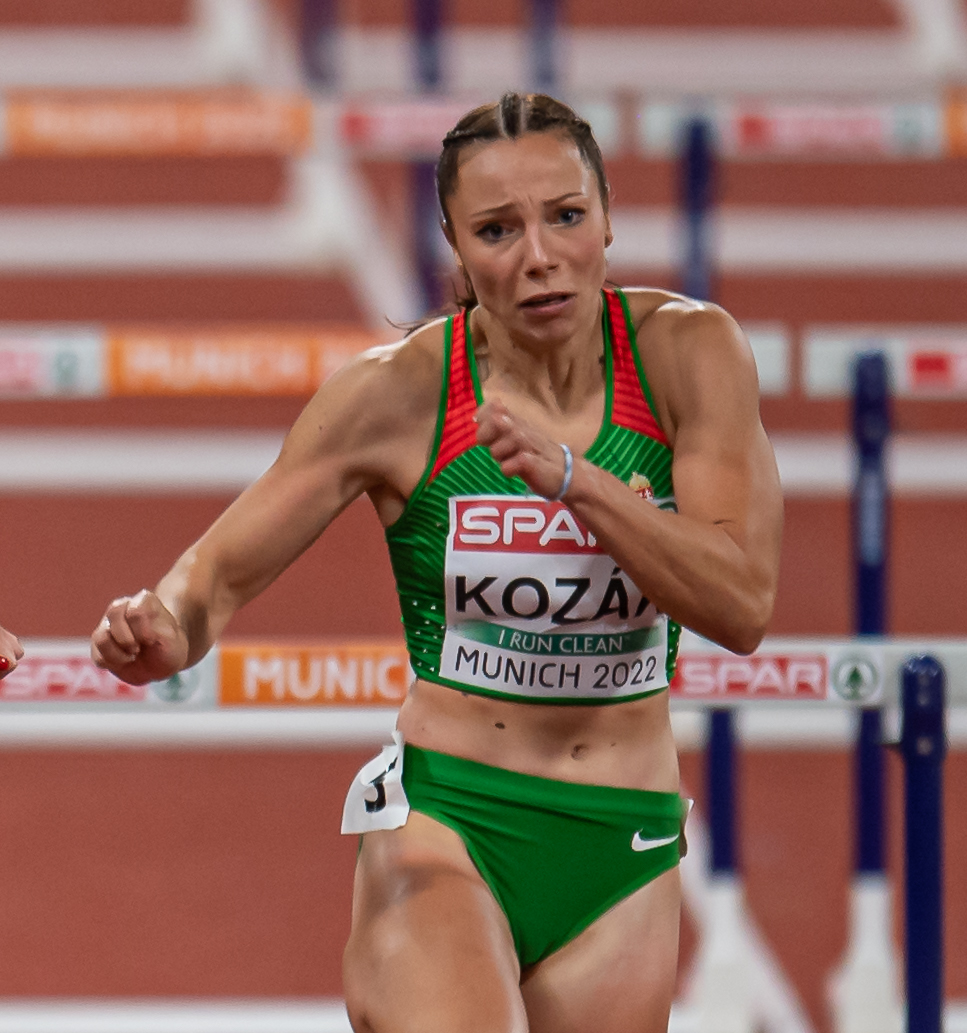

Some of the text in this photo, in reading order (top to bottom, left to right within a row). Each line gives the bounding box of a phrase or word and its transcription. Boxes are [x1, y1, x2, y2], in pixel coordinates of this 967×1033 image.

[459, 506, 596, 547] SPA
[455, 567, 650, 624] KOZÁ
[498, 630, 623, 653] I RUN CLEAN
[243, 656, 406, 700] MUNIC
[455, 646, 657, 689] MUNICH 2022
[683, 661, 823, 697] SPAR
